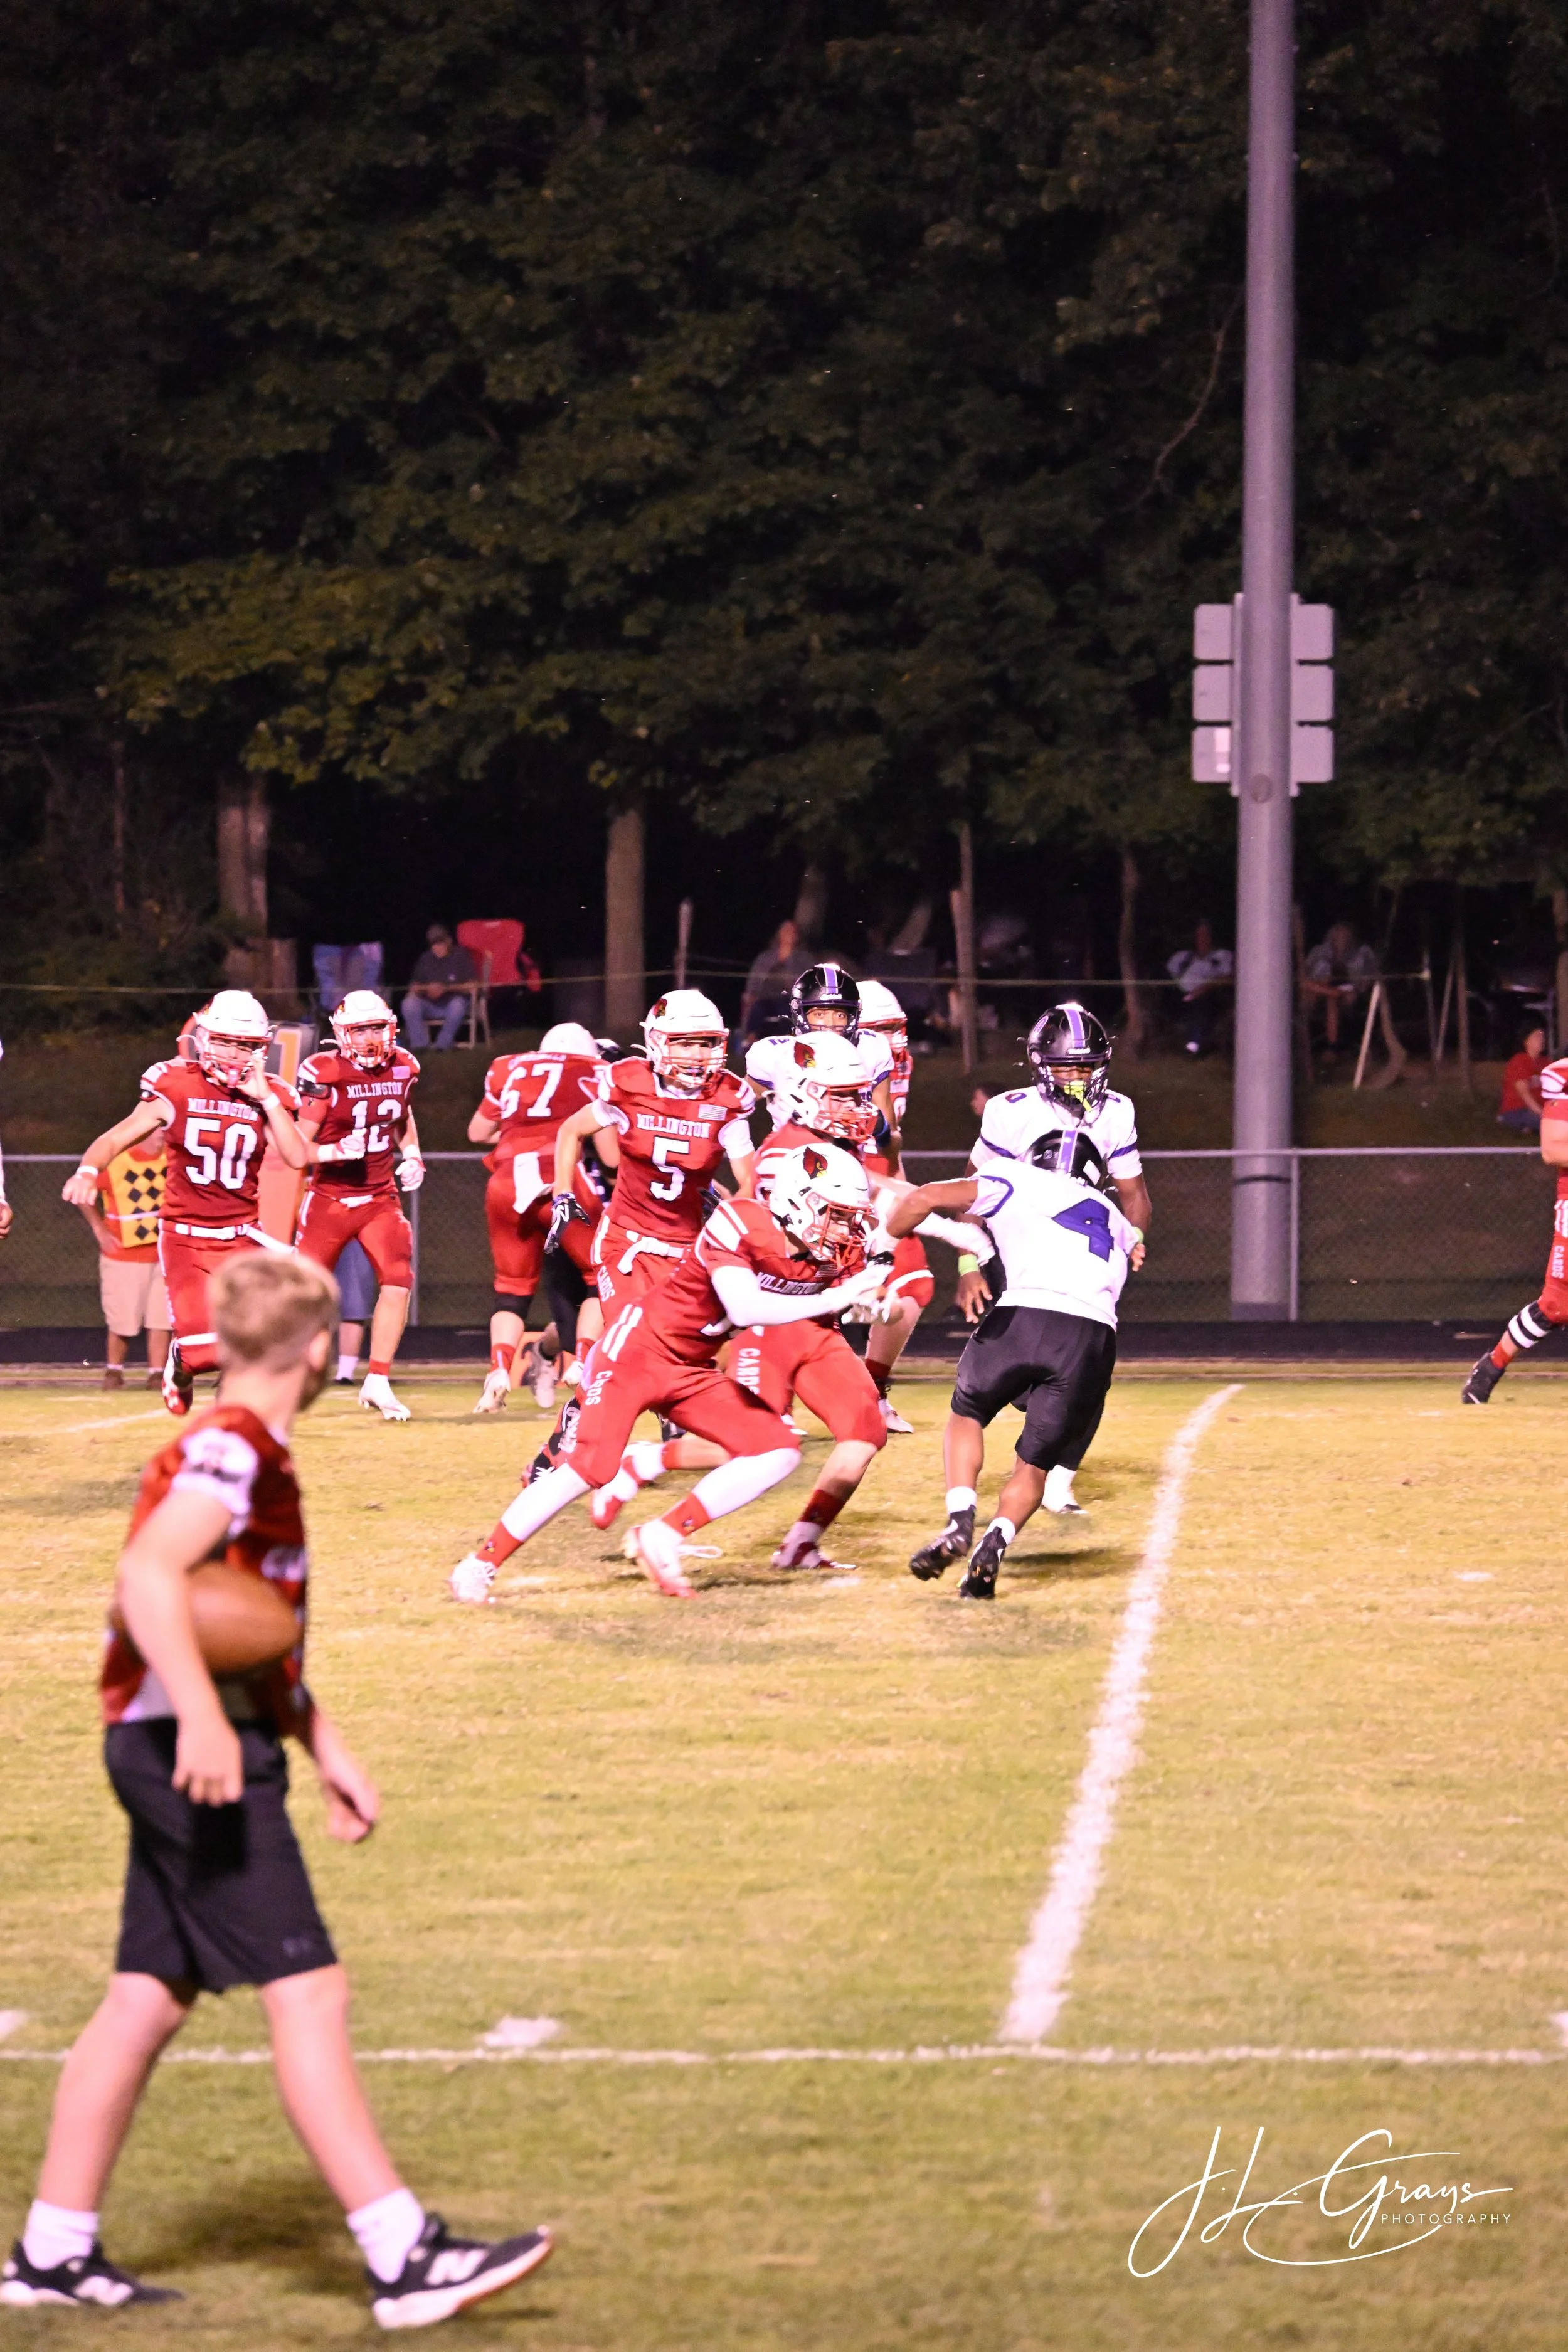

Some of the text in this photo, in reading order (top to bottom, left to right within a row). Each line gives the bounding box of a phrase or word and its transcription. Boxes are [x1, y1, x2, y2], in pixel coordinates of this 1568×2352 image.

[273, 1029, 302, 1088] 1
[346, 1081, 403, 1098] MILLINGTON
[499, 1063, 564, 1119] 67
[184, 1117, 258, 1189] 50
[637, 1113, 711, 1138] MILLINGTON
[650, 1136, 689, 1201] 5
[1051, 1197, 1115, 1263] 4
